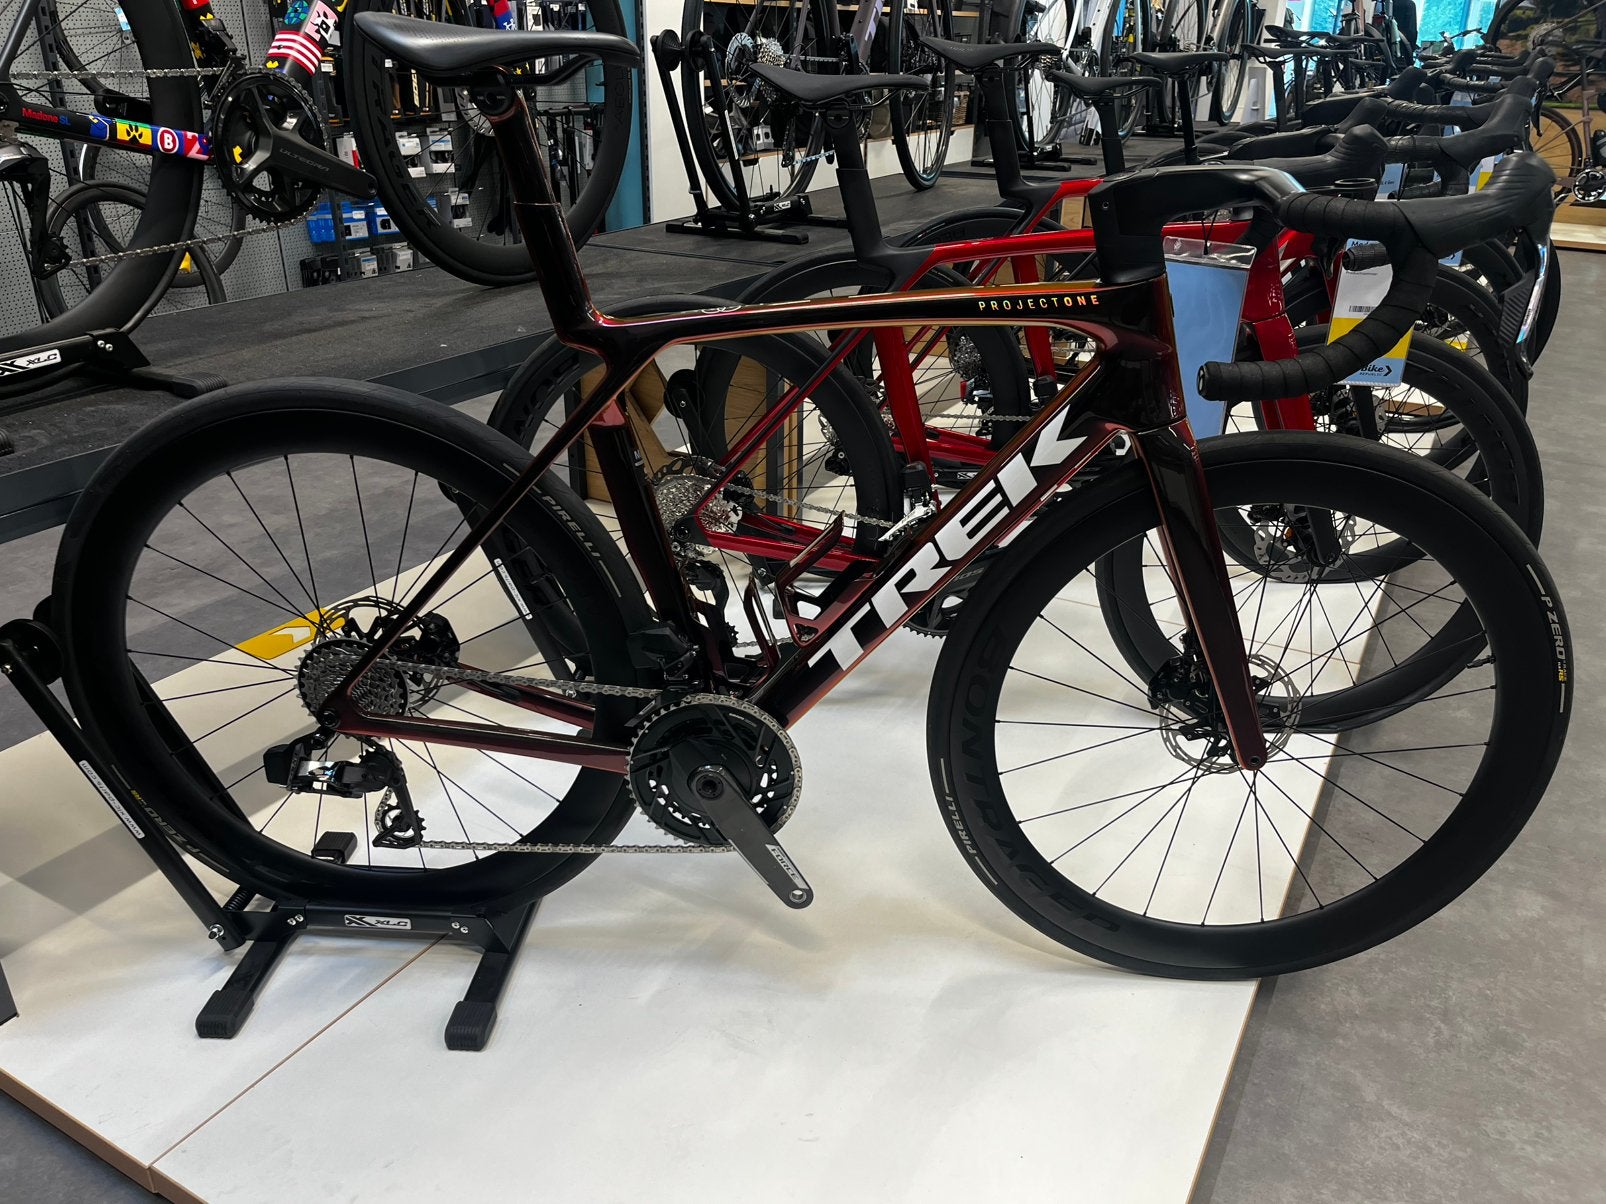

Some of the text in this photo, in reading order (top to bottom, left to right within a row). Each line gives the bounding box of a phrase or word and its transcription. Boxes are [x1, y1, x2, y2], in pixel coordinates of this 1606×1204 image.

[22, 107, 71, 126] Madone SL
[26, 353, 58, 366] XLC
[541, 495, 601, 558] PIRELLI
[807, 404, 1088, 671] TREK
[1541, 596, 1552, 608] P
[1546, 610, 1566, 660] ZERO
[81, 761, 142, 837] www.xlc-parts.com
[945, 796, 977, 855] PIRELLI
[770, 847, 799, 880] FORCE
[374, 919, 409, 927] XLC
